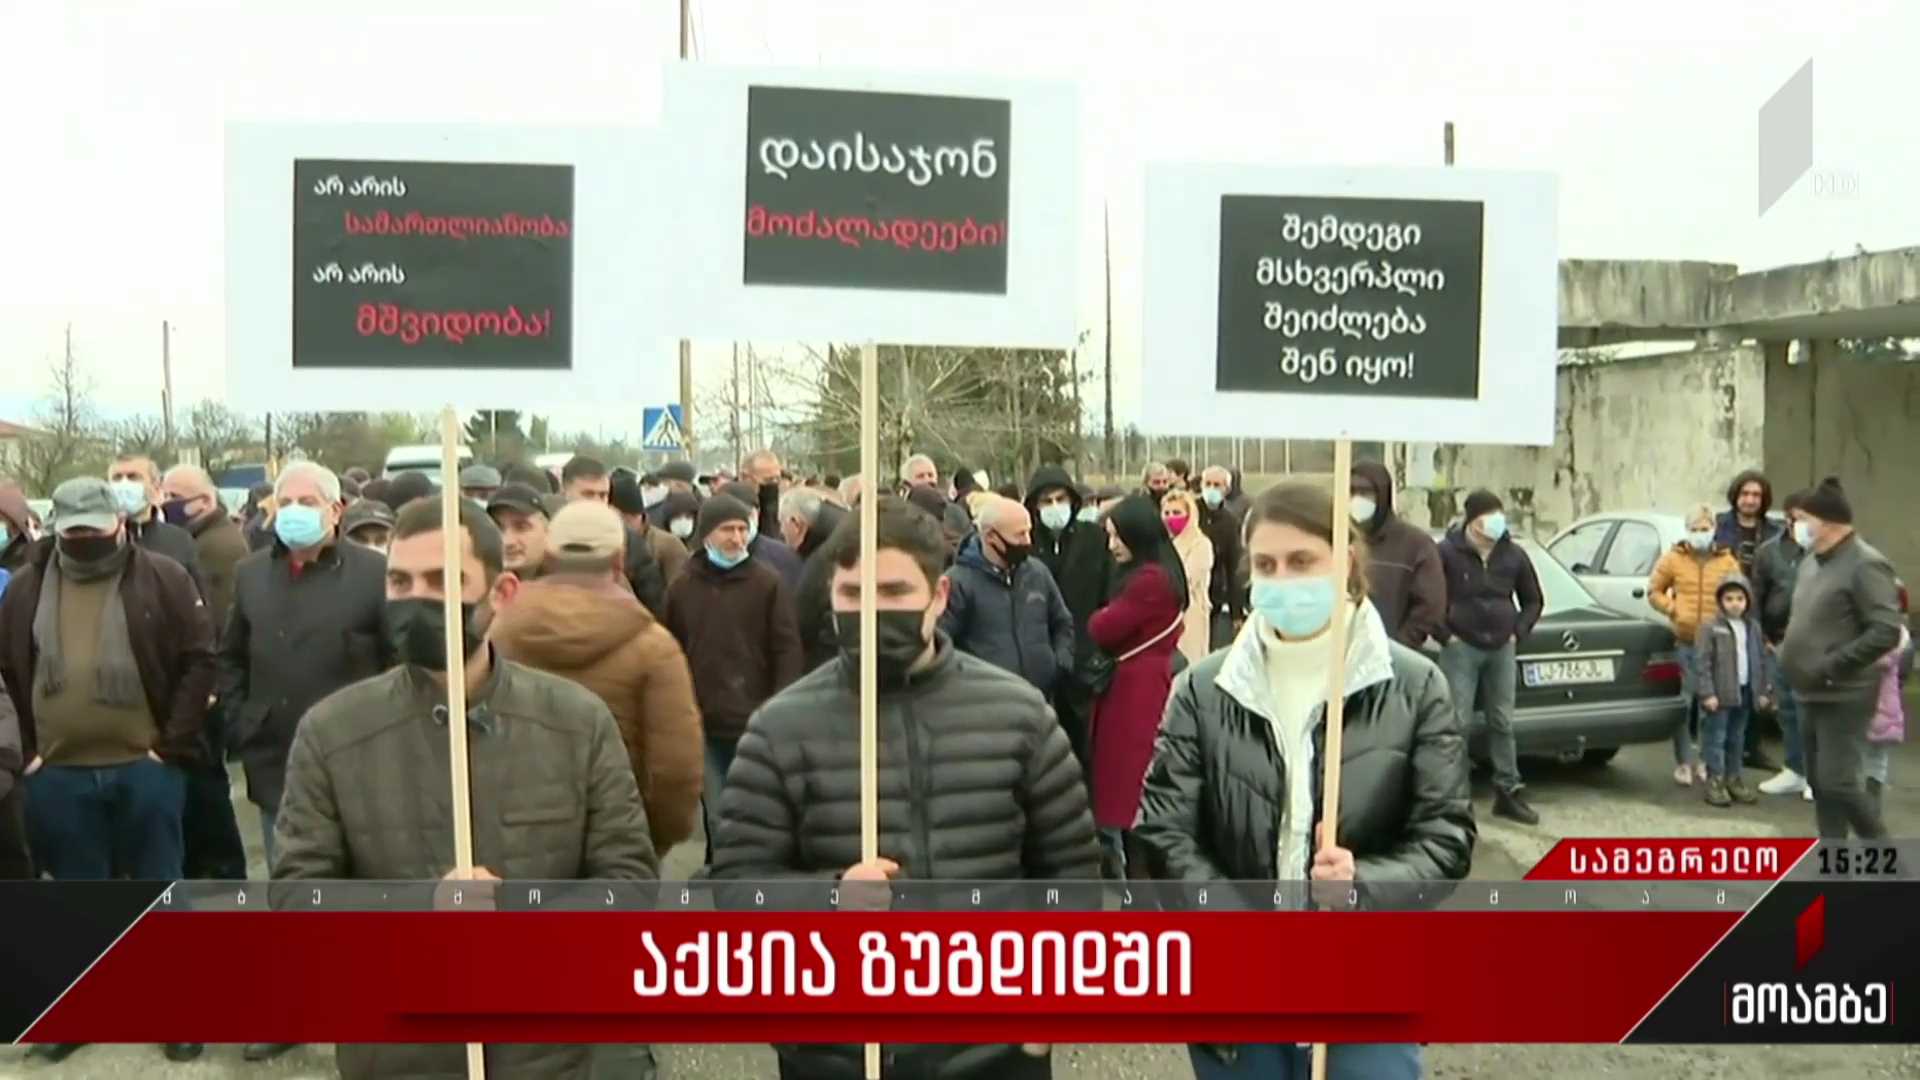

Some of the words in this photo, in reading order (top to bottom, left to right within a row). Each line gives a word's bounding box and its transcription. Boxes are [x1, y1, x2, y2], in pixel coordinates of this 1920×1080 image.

[760, 131, 997, 186] დაისაჯონ
[313, 174, 344, 196] არ
[349, 174, 407, 197] არის
[344, 211, 572, 240] სამართლიანობა
[747, 204, 1006, 252] მოძალადეები!
[1282, 213, 1421, 251] შემდეგი
[312, 261, 343, 284] არ
[348, 261, 406, 285] არის
[1256, 257, 1445, 297] მსხვერპლი
[356, 302, 553, 344] მშვიდობა!
[1264, 301, 1427, 340] შეიძლება
[1281, 346, 1337, 383] შენ
[1345, 352, 1414, 384] იყო!
